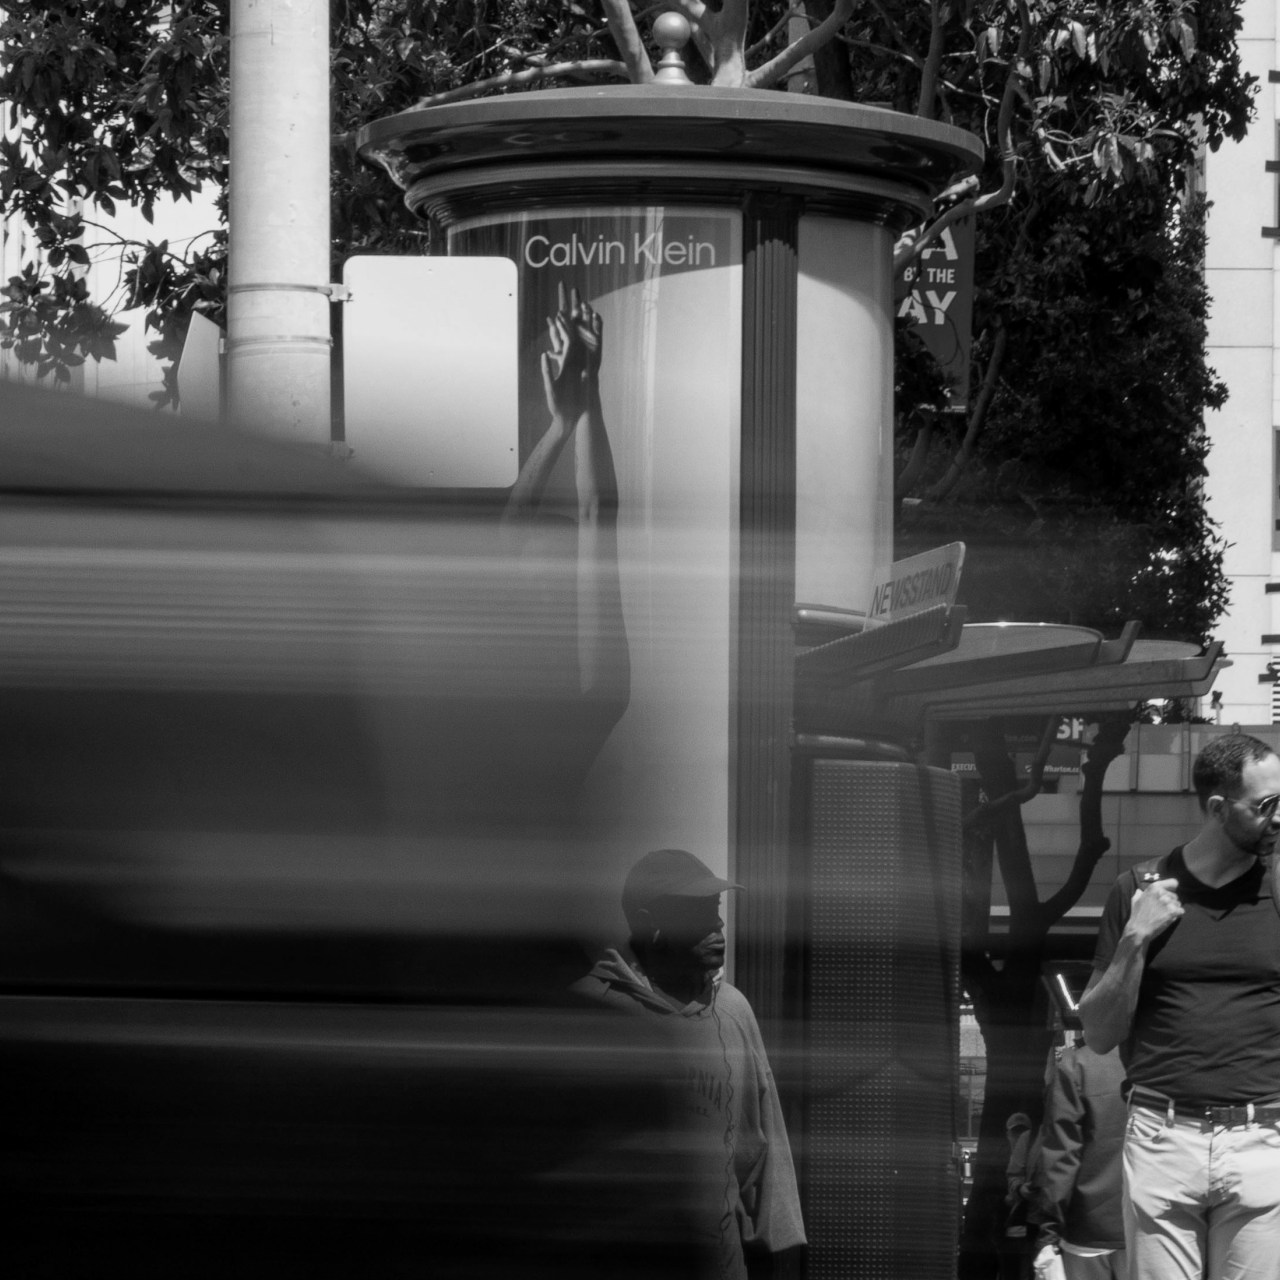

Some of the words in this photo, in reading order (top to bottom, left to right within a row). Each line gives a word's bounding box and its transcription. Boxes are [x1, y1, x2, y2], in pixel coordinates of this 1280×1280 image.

[525, 232, 625, 268] Calvin
[634, 232, 716, 266] Klein
[927, 267, 955, 284] THE
[869, 562, 954, 618] NEWSSTAND
